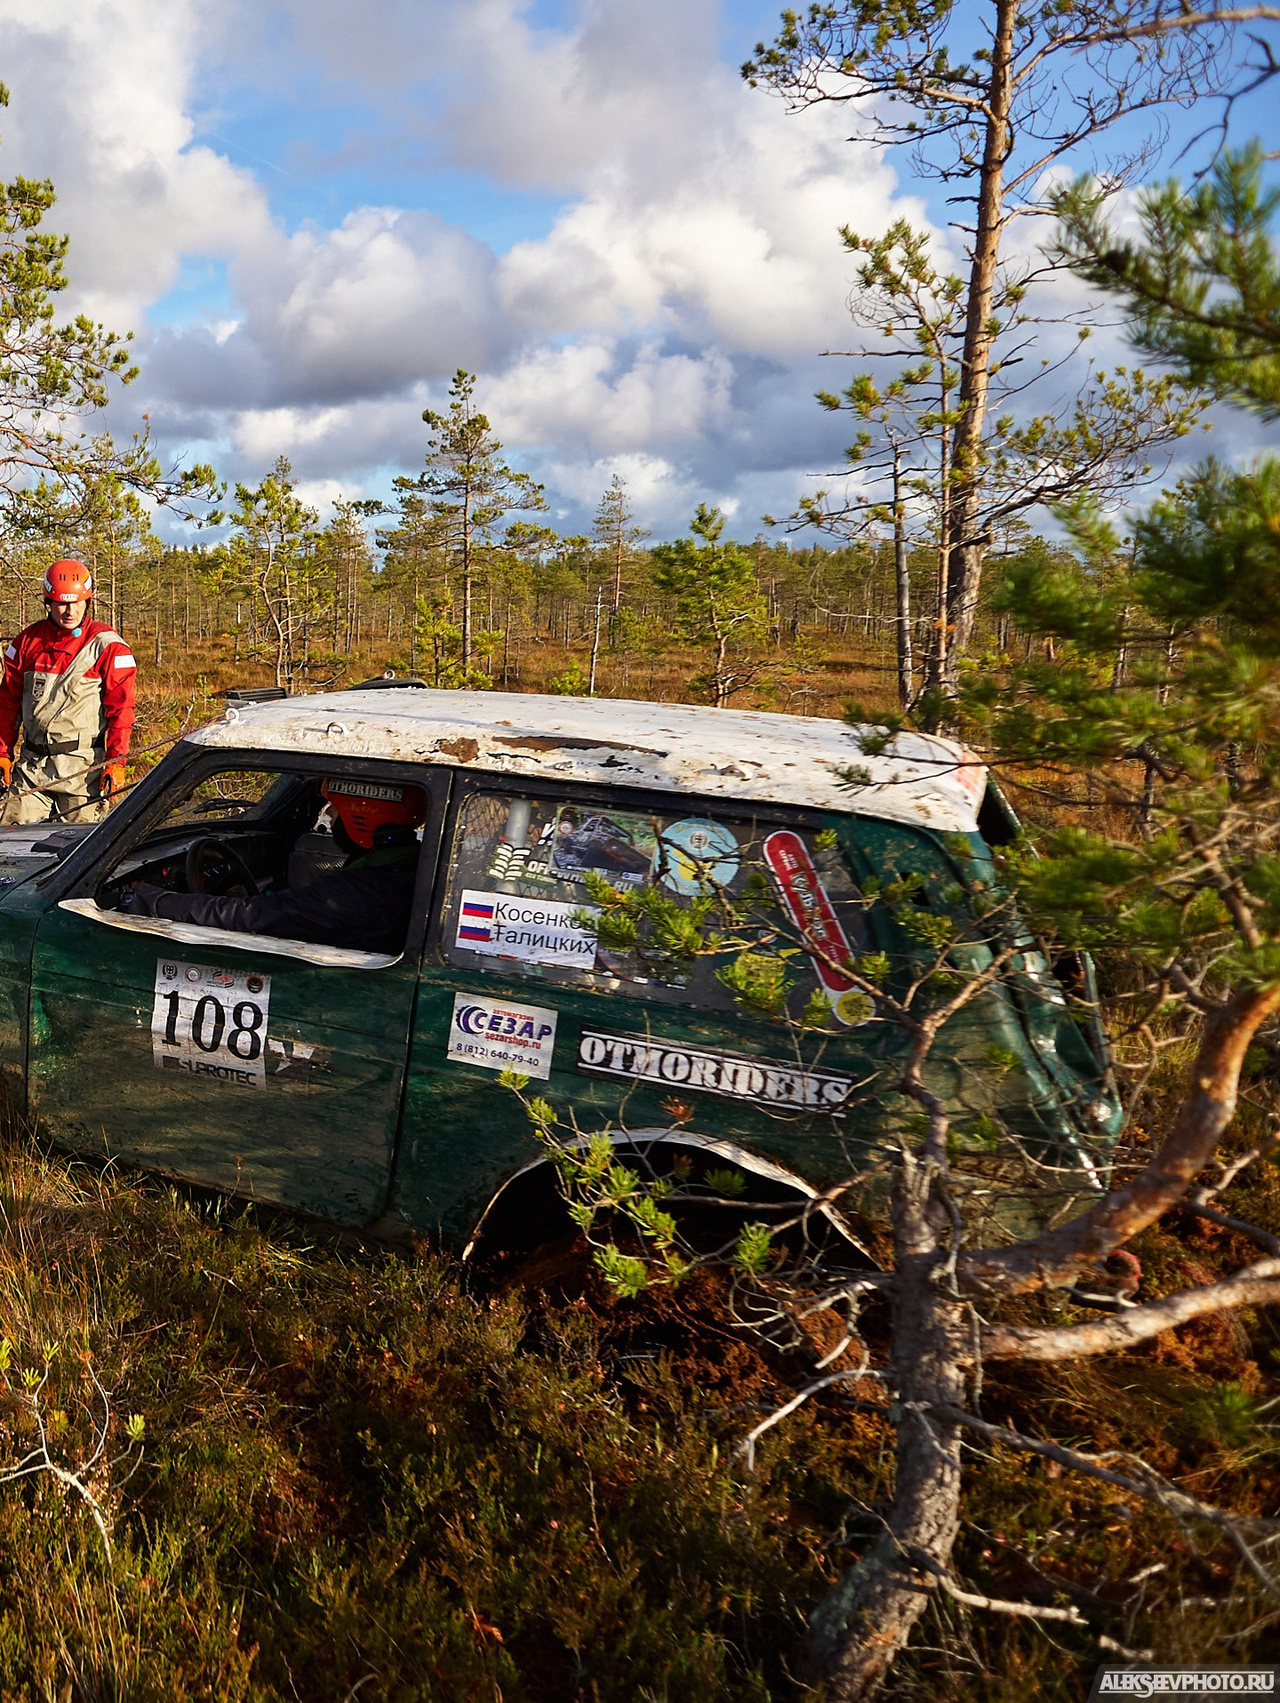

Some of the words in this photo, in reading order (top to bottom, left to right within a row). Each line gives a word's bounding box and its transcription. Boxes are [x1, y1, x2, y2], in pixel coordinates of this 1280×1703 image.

[493, 923, 595, 955] Талицких
[161, 990, 263, 1060] 108
[474, 1012, 552, 1041] СЕЗАР
[493, 1009, 534, 1021] автомагазин
[456, 1043, 463, 1051] 8
[464, 1044, 488, 1057] (812)
[490, 1050, 539, 1067] 640-79-40
[484, 1032, 541, 1050] sezarshop.ru
[178, 1059, 257, 1086] SUPROTEC
[579, 1036, 849, 1105] OTMORIDERS
